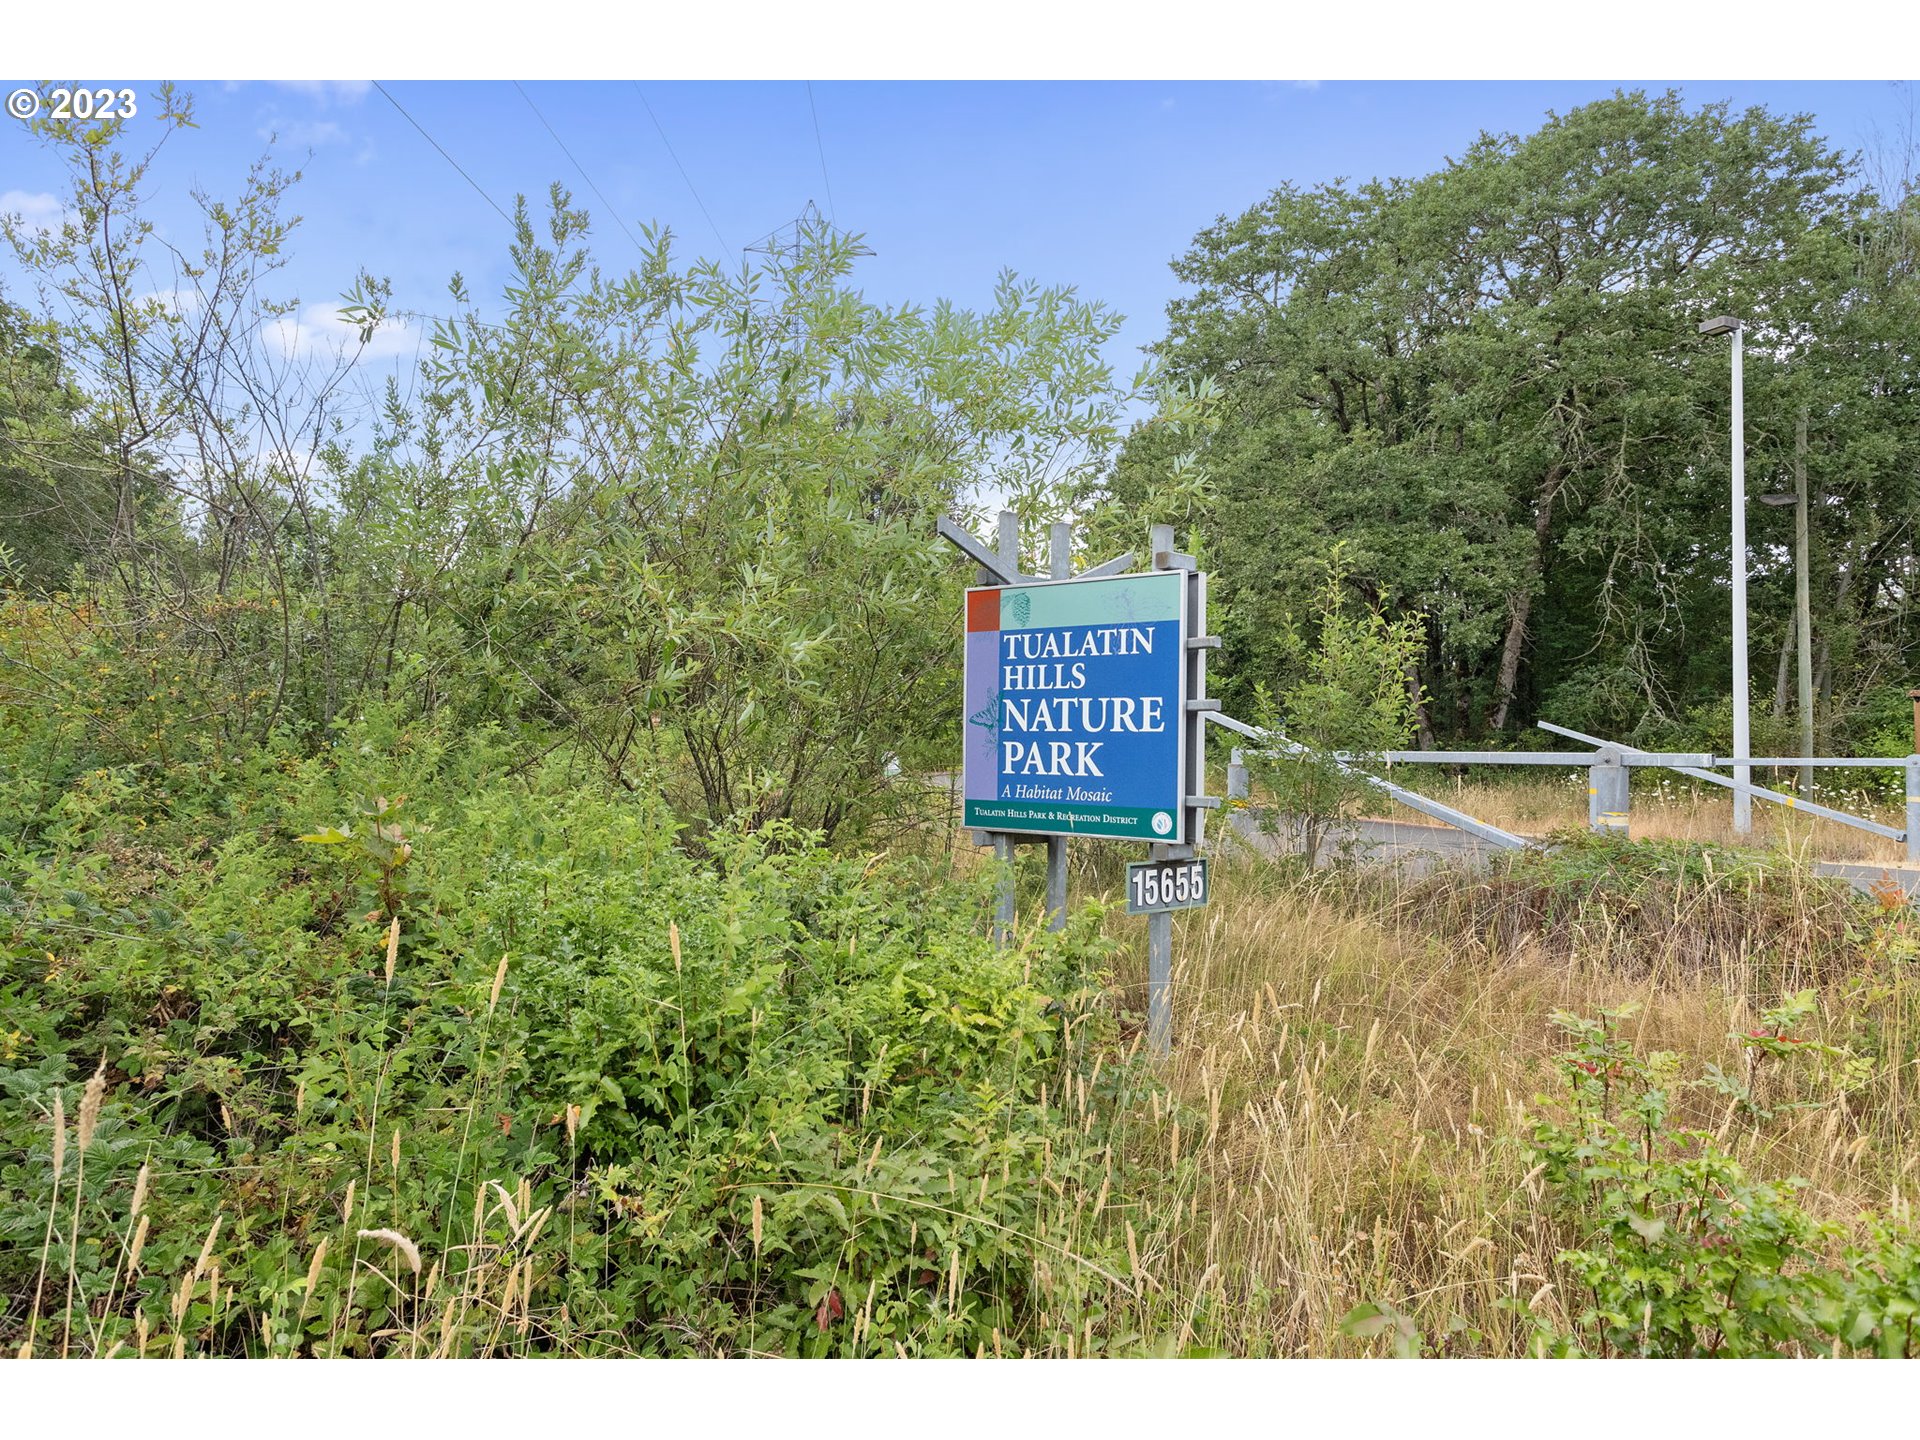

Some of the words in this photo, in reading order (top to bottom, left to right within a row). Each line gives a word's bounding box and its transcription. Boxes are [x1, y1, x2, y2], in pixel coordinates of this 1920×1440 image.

[1003, 627, 1155, 660] TUALATIN
[1003, 662, 1086, 691] HILLS
[1002, 696, 1165, 733] NATURE
[1002, 741, 1104, 777] PARK
[1001, 785, 1011, 798] A
[1015, 785, 1063, 800] Habitat
[1066, 786, 1113, 803] Mosaic
[974, 807, 1006, 817] TUALATIN
[1007, 809, 1027, 818] HILLS
[1028, 810, 1047, 820] PARK
[1048, 811, 1055, 820] &
[1103, 814, 1138, 825] DISTRICT
[1132, 865, 1204, 907] 15655
